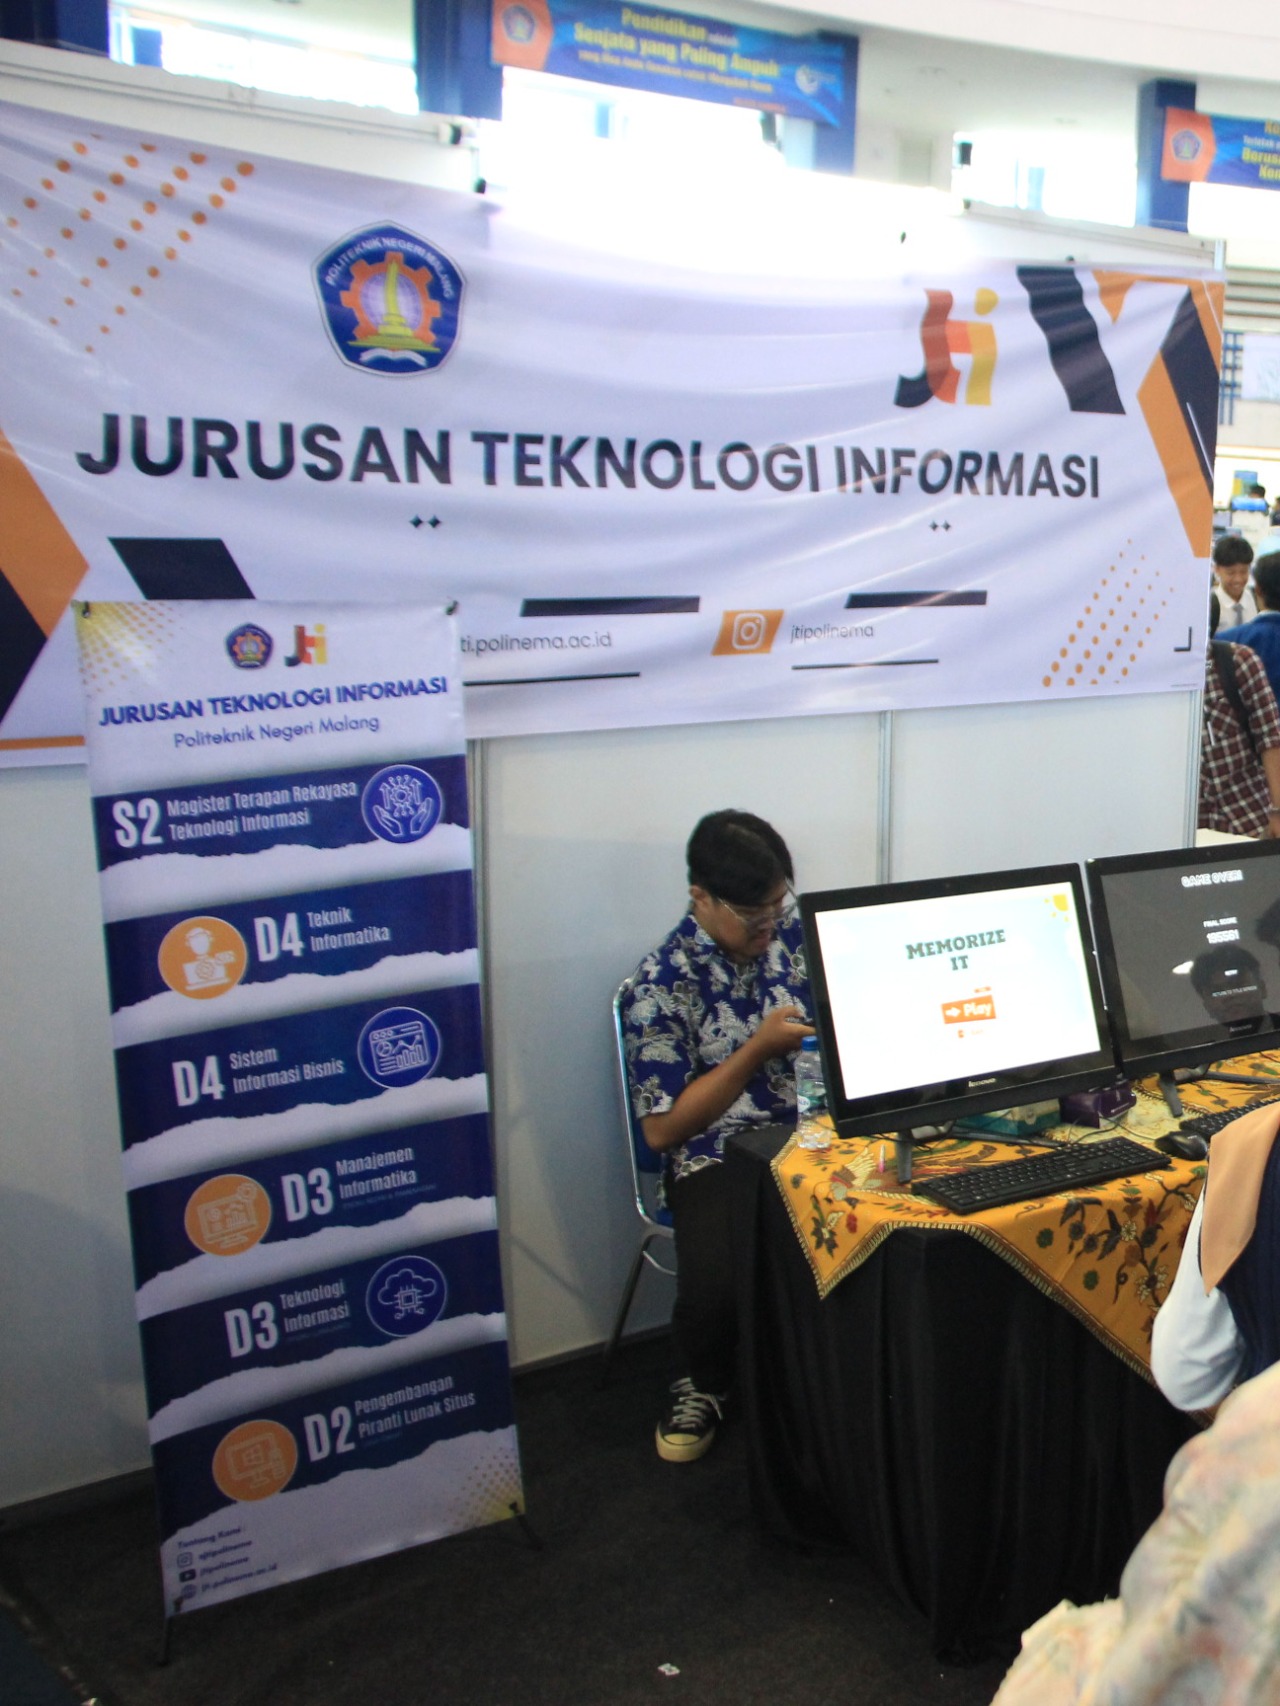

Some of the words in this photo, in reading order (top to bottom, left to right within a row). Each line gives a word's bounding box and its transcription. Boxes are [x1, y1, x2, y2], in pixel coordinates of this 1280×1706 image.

[574, 22, 636, 50] Senjata
[639, 38, 676, 62] yang
[681, 43, 727, 71] Paling
[325, 237, 382, 287] POLITEKNIK
[382, 237, 425, 258] NEGERI
[425, 251, 455, 299] MALANG
[76, 413, 451, 486] JURUSAN
[472, 431, 819, 494] TEKNOLOGI
[835, 446, 1101, 500] INFORMASI
[459, 630, 613, 655] ti.polinema.ac.id
[789, 622, 875, 643] jtipolinema
[99, 699, 203, 726] JURUSAN
[207, 686, 332, 716] TEKNOLOGI
[336, 676, 448, 704] INFORMASI
[174, 721, 255, 749] Politeknik
[260, 720, 314, 743] Negeri
[319, 714, 381, 734] Malang
[167, 793, 231, 817] Magister
[234, 787, 290, 812] Terapan
[292, 780, 358, 803] Rekayasa
[113, 797, 163, 850] S2
[169, 814, 239, 842] Teknologi
[242, 808, 311, 833] Informasi
[1181, 873, 1212, 888] GAME
[307, 906, 352, 929] Teknik
[254, 912, 304, 963] D4
[311, 925, 391, 952] Informatika
[905, 929, 1006, 960] MEMORIZE
[950, 955, 969, 971] IT
[963, 1002, 992, 1017] Play
[230, 1048, 278, 1070] Sistem
[233, 1064, 300, 1094] Informasi
[303, 1058, 345, 1081] Bisnis
[172, 1055, 225, 1107] D4
[968, 1077, 996, 1088] lenovo
[336, 1147, 414, 1177] Manajemen
[281, 1167, 333, 1223] D3
[339, 1170, 417, 1200] Informatika
[280, 1278, 345, 1310] Teknologi
[224, 1301, 279, 1358] D3
[284, 1300, 350, 1333] Informasi
[355, 1376, 453, 1416] Pengembangan
[359, 1411, 402, 1439] Piranti
[404, 1401, 442, 1425] Lunak
[443, 1392, 476, 1413] Situs
[304, 1406, 356, 1462] D2
